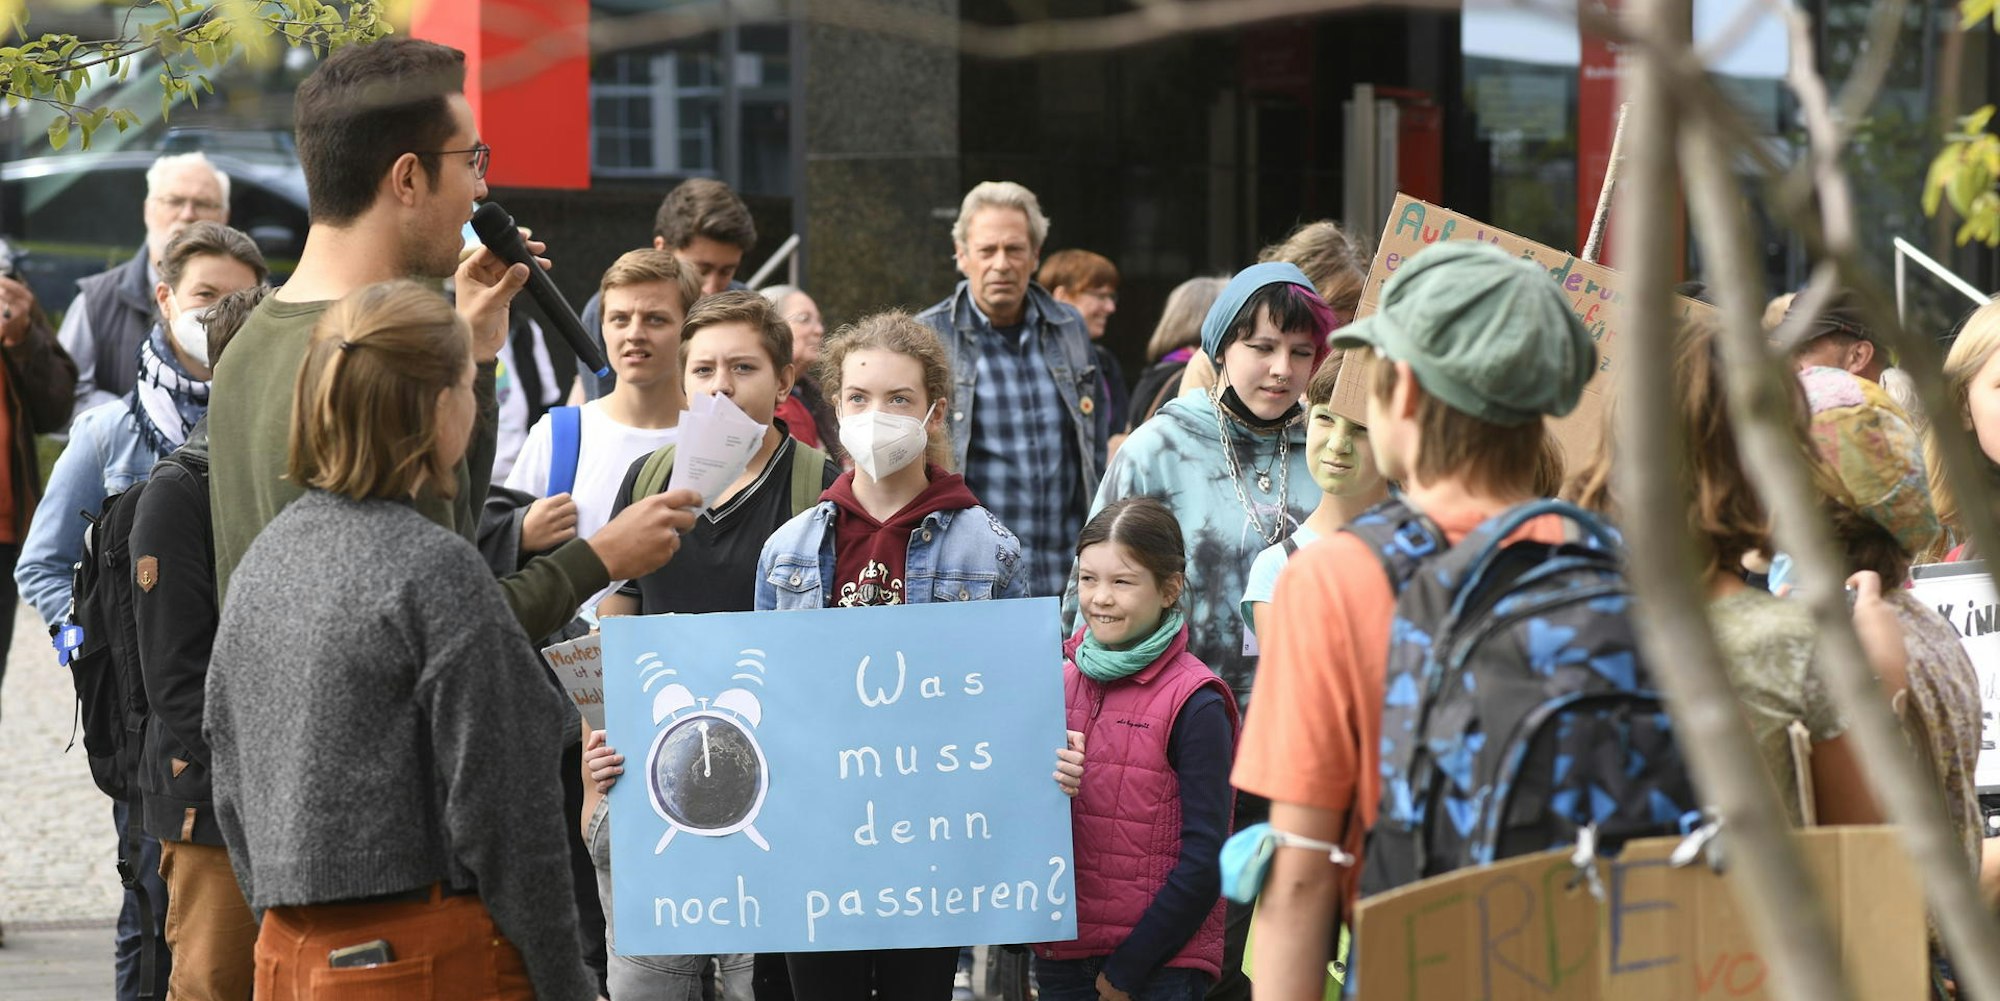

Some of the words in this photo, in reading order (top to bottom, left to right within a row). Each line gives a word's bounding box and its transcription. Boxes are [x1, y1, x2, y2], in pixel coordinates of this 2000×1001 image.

[1395, 202, 1457, 245] Auf
[855, 650, 986, 709] Was
[838, 741, 993, 782] muss
[851, 800, 991, 846] denn
[652, 873, 761, 928] noch
[805, 855, 1066, 942] passieren?
